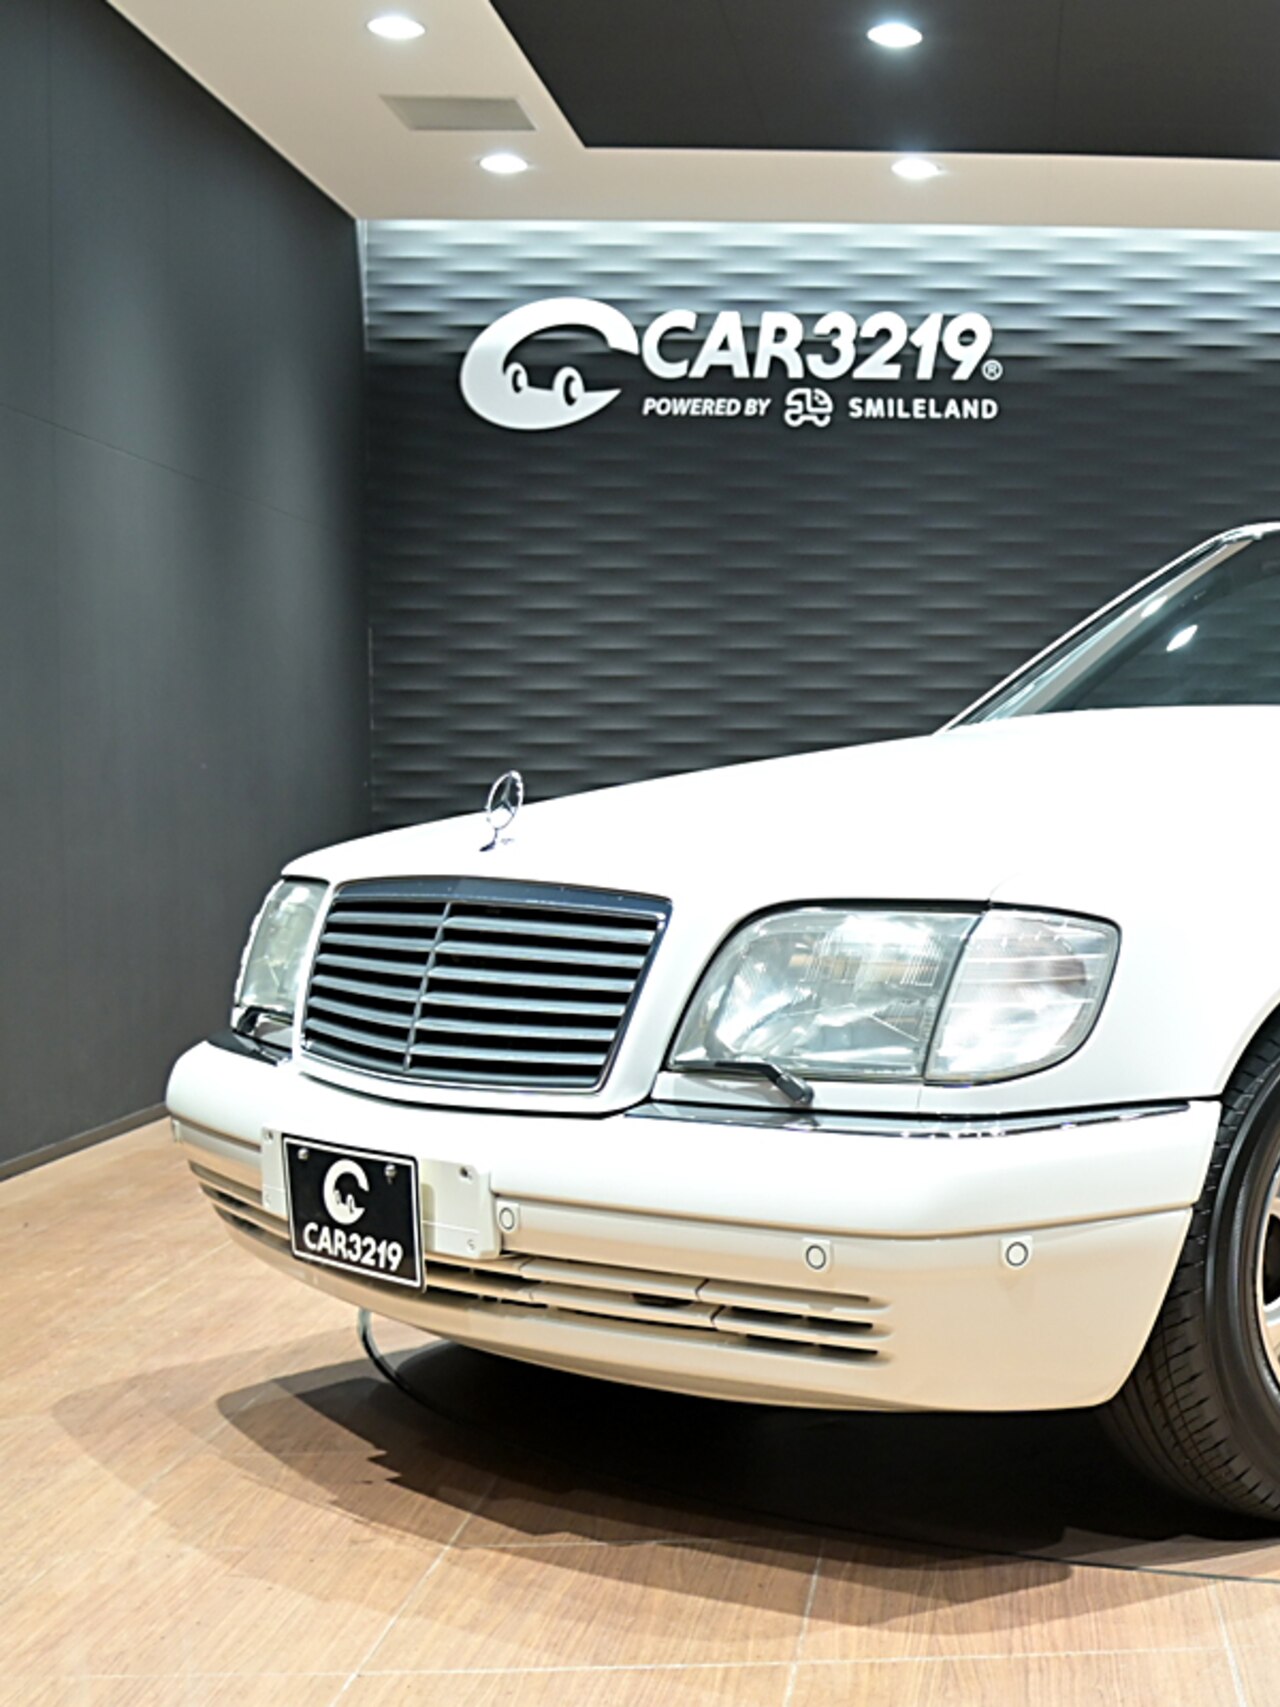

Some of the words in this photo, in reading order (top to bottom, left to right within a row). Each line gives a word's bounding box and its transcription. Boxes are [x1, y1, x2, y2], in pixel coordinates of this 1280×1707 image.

[642, 397, 740, 417] POWERED
[743, 397, 772, 417] BY
[848, 397, 999, 419] SMILELAND
[303, 1221, 404, 1272] CAR3219
